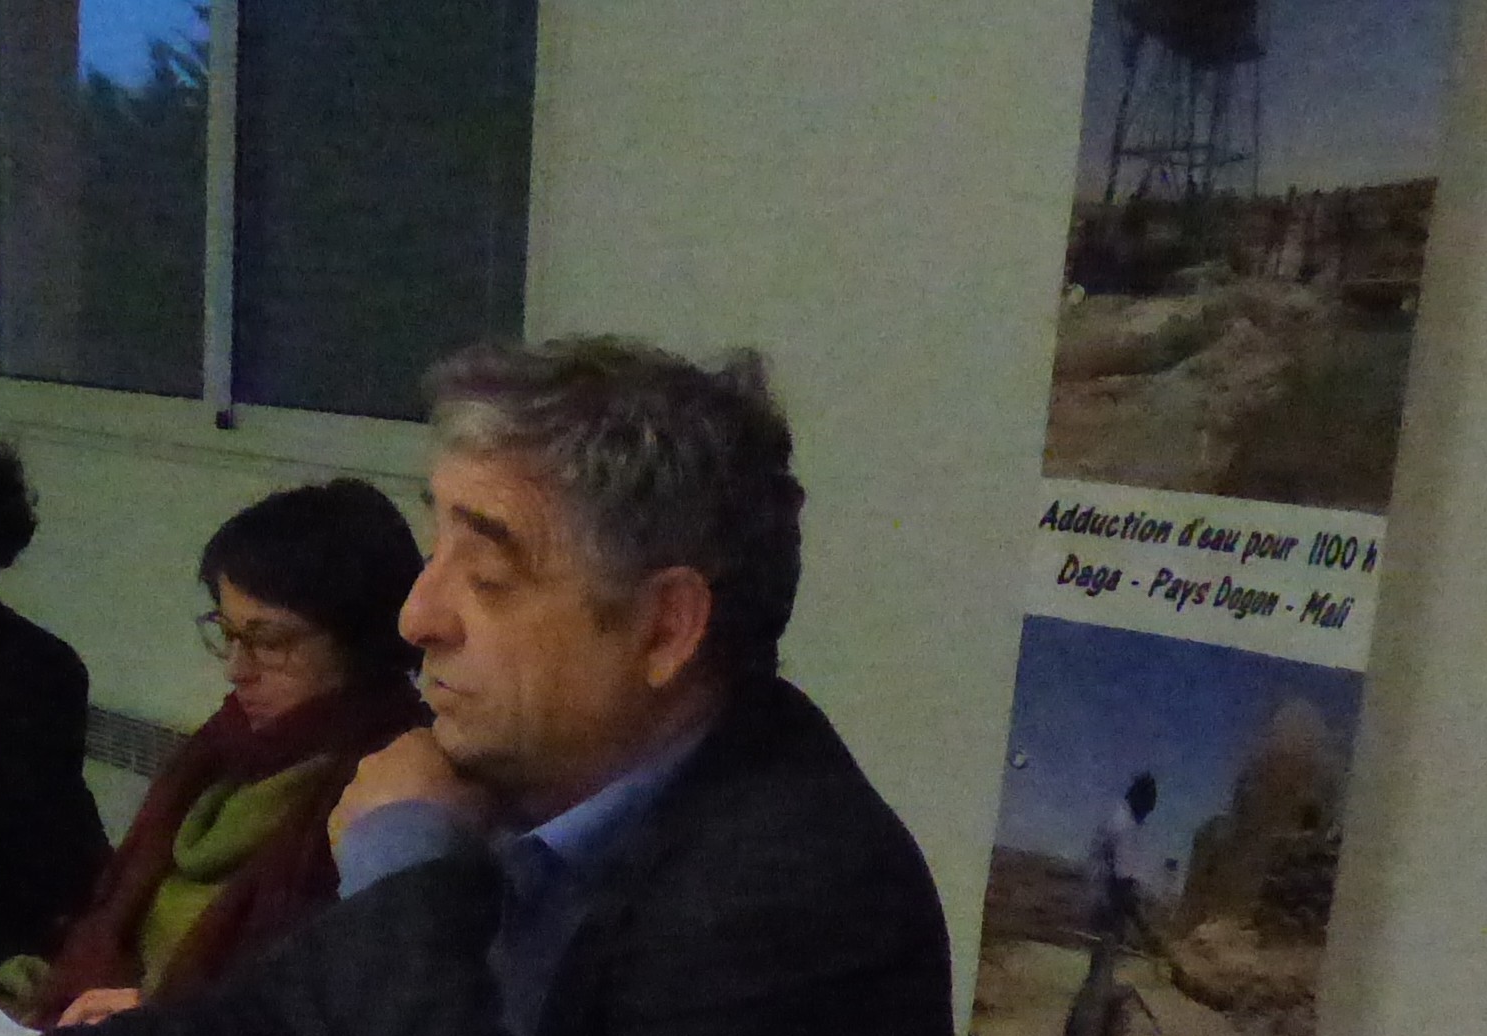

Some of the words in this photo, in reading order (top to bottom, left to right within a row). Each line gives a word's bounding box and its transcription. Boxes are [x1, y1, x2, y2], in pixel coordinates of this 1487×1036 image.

[1039, 500, 1173, 543] Adduction
[1178, 517, 1241, 552] d'eau
[1241, 530, 1299, 564] pour
[1057, 553, 1123, 597] Daga
[1148, 567, 1211, 612] Pays
[1213, 575, 1280, 619] Dogon
[1299, 590, 1355, 629] Mali
